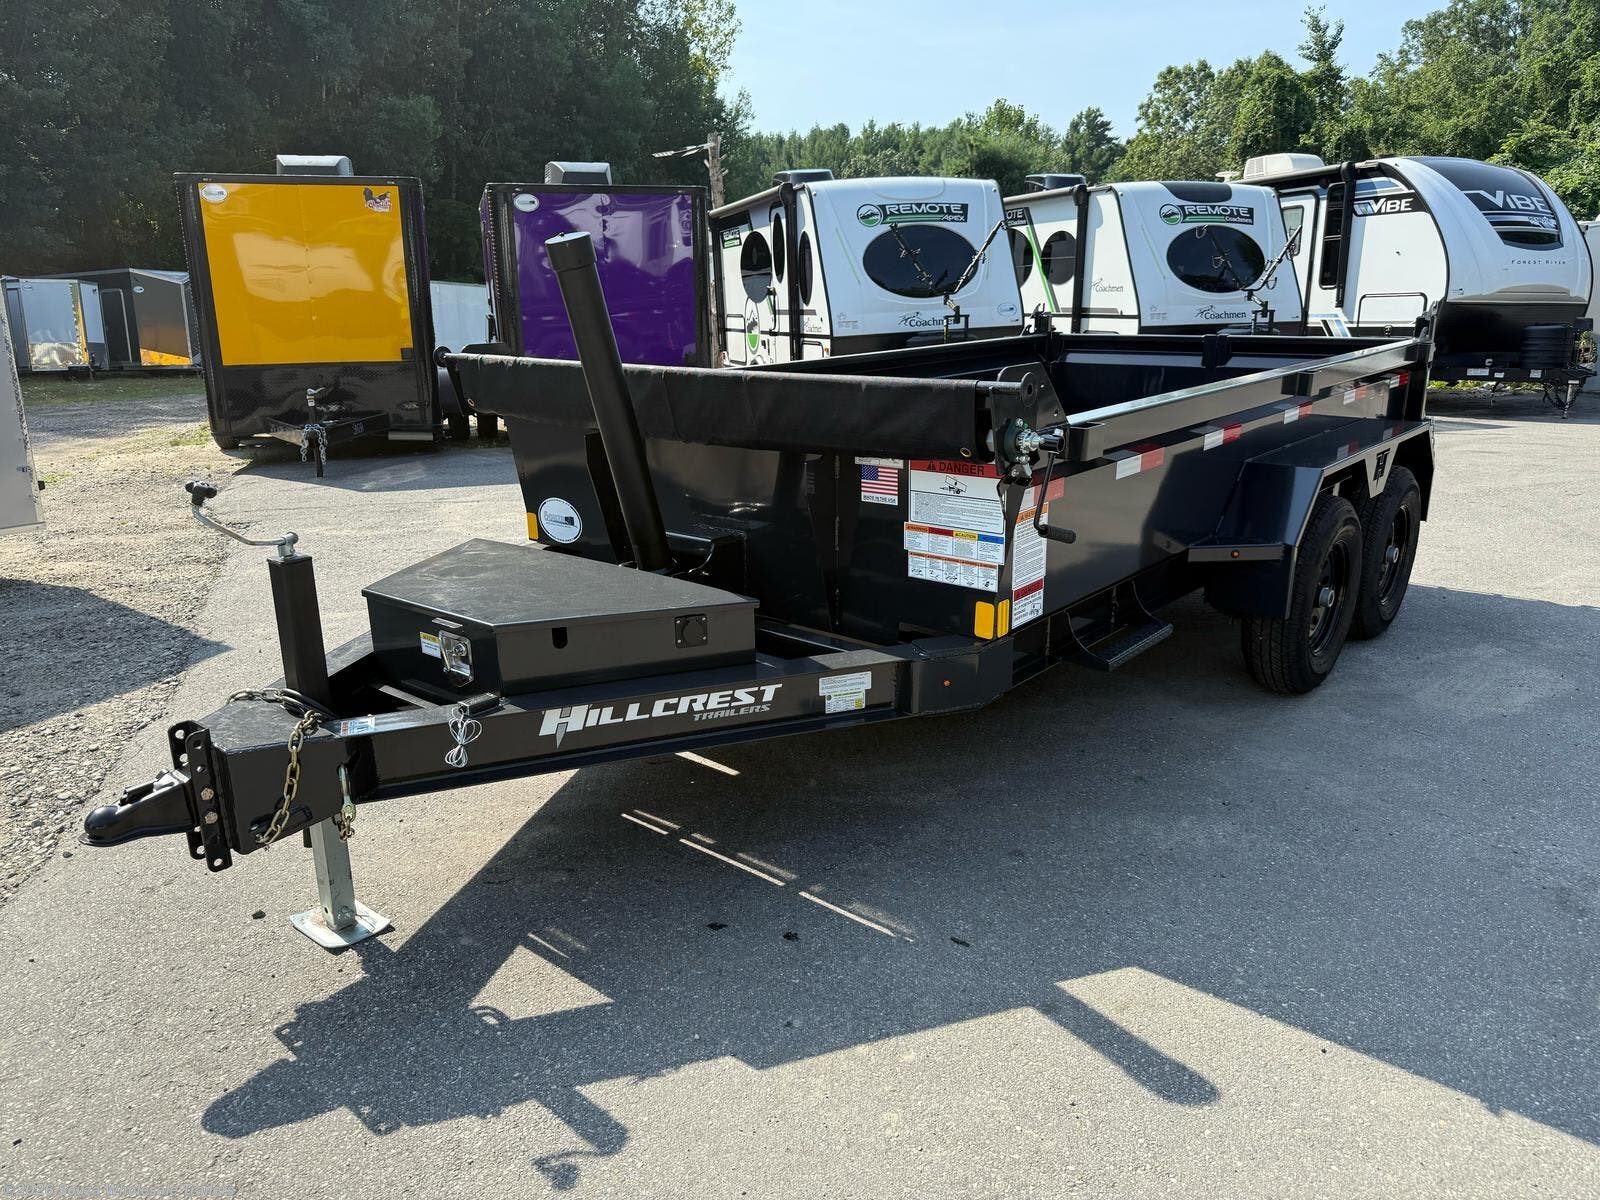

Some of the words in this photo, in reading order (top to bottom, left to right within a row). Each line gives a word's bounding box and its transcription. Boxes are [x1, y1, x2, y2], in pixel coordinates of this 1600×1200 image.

[1362, 198, 1414, 213] VIBE
[1461, 190, 1553, 214] VIBE
[885, 204, 963, 214] REMOTE
[1007, 209, 1023, 219] OTE
[1184, 206, 1250, 217] REMOTE
[1204, 310, 1247, 320] Coachmen
[908, 317, 955, 328] Coachme
[939, 461, 985, 476] DANGER
[958, 532, 977, 540] CAUTION
[539, 684, 783, 746] HILLCREST
[693, 704, 771, 721] TRAILERS
